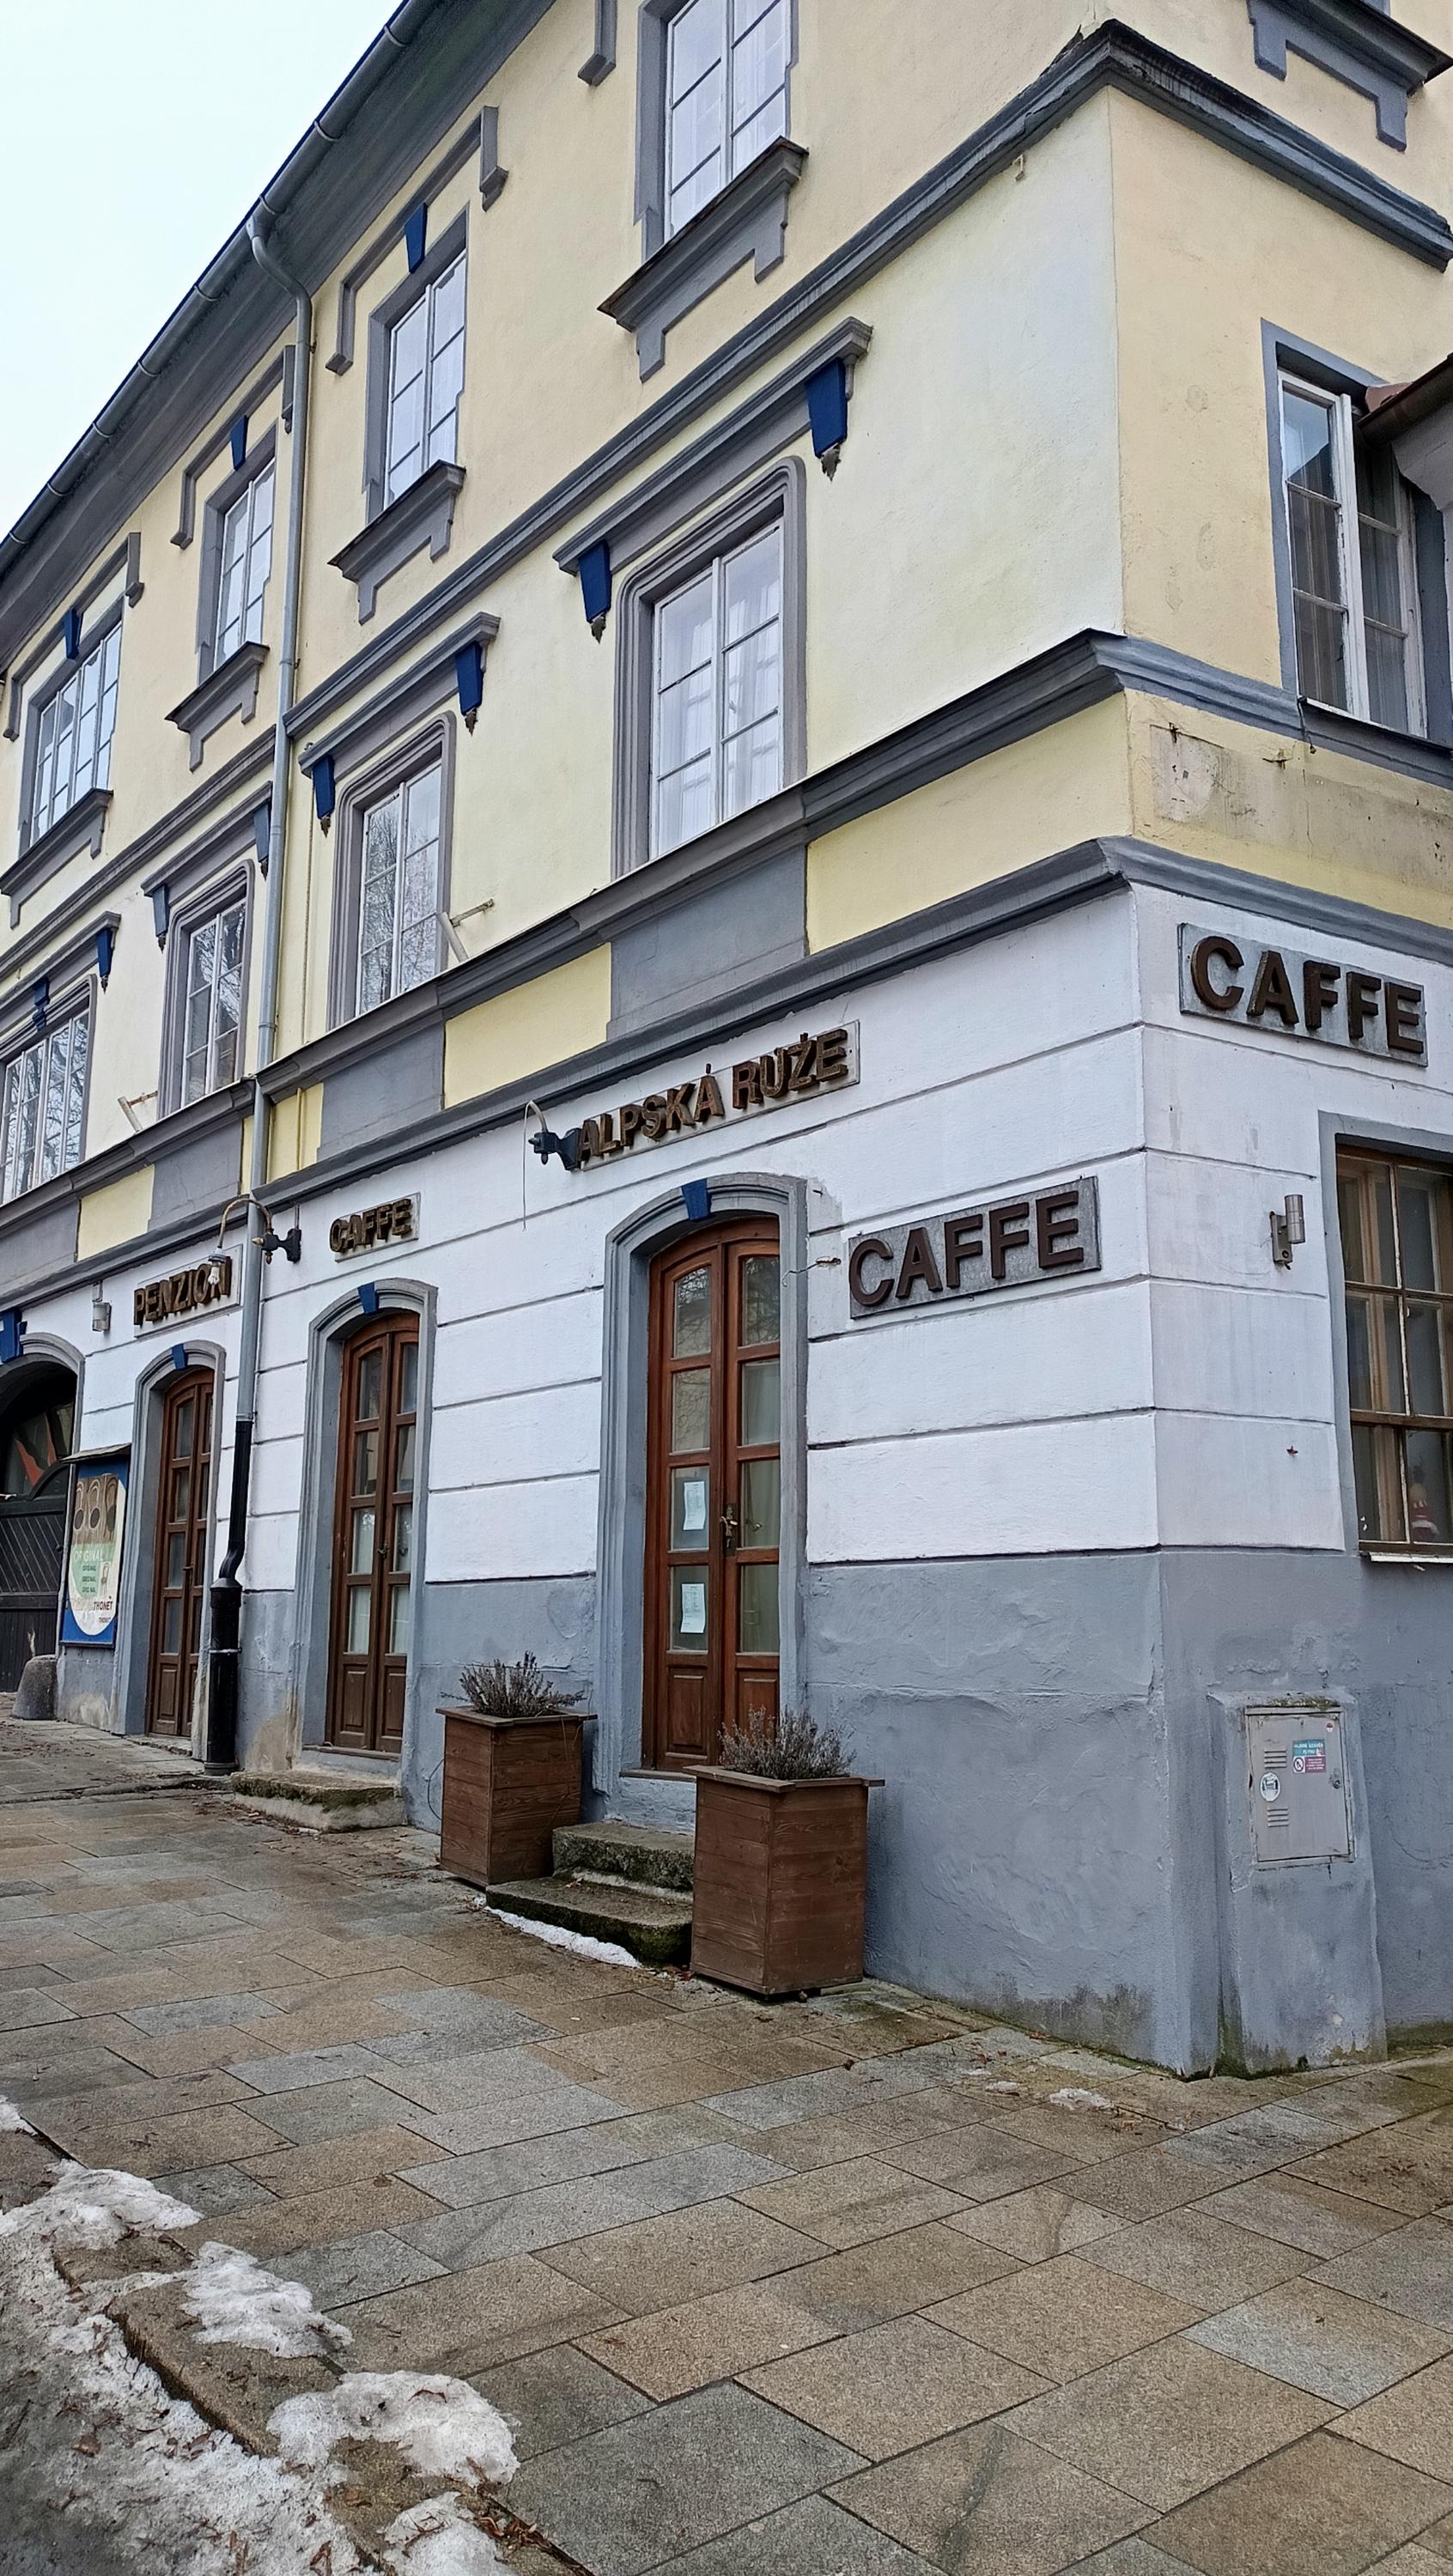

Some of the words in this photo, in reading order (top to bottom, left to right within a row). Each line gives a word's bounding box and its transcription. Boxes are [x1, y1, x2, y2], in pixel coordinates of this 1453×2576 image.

[1191, 935, 1424, 1054] CAFFE
[578, 1063, 726, 1161] ALPSKÁ
[329, 1198, 412, 1252] CAFFE
[849, 1190, 1084, 1306] CAFFE
